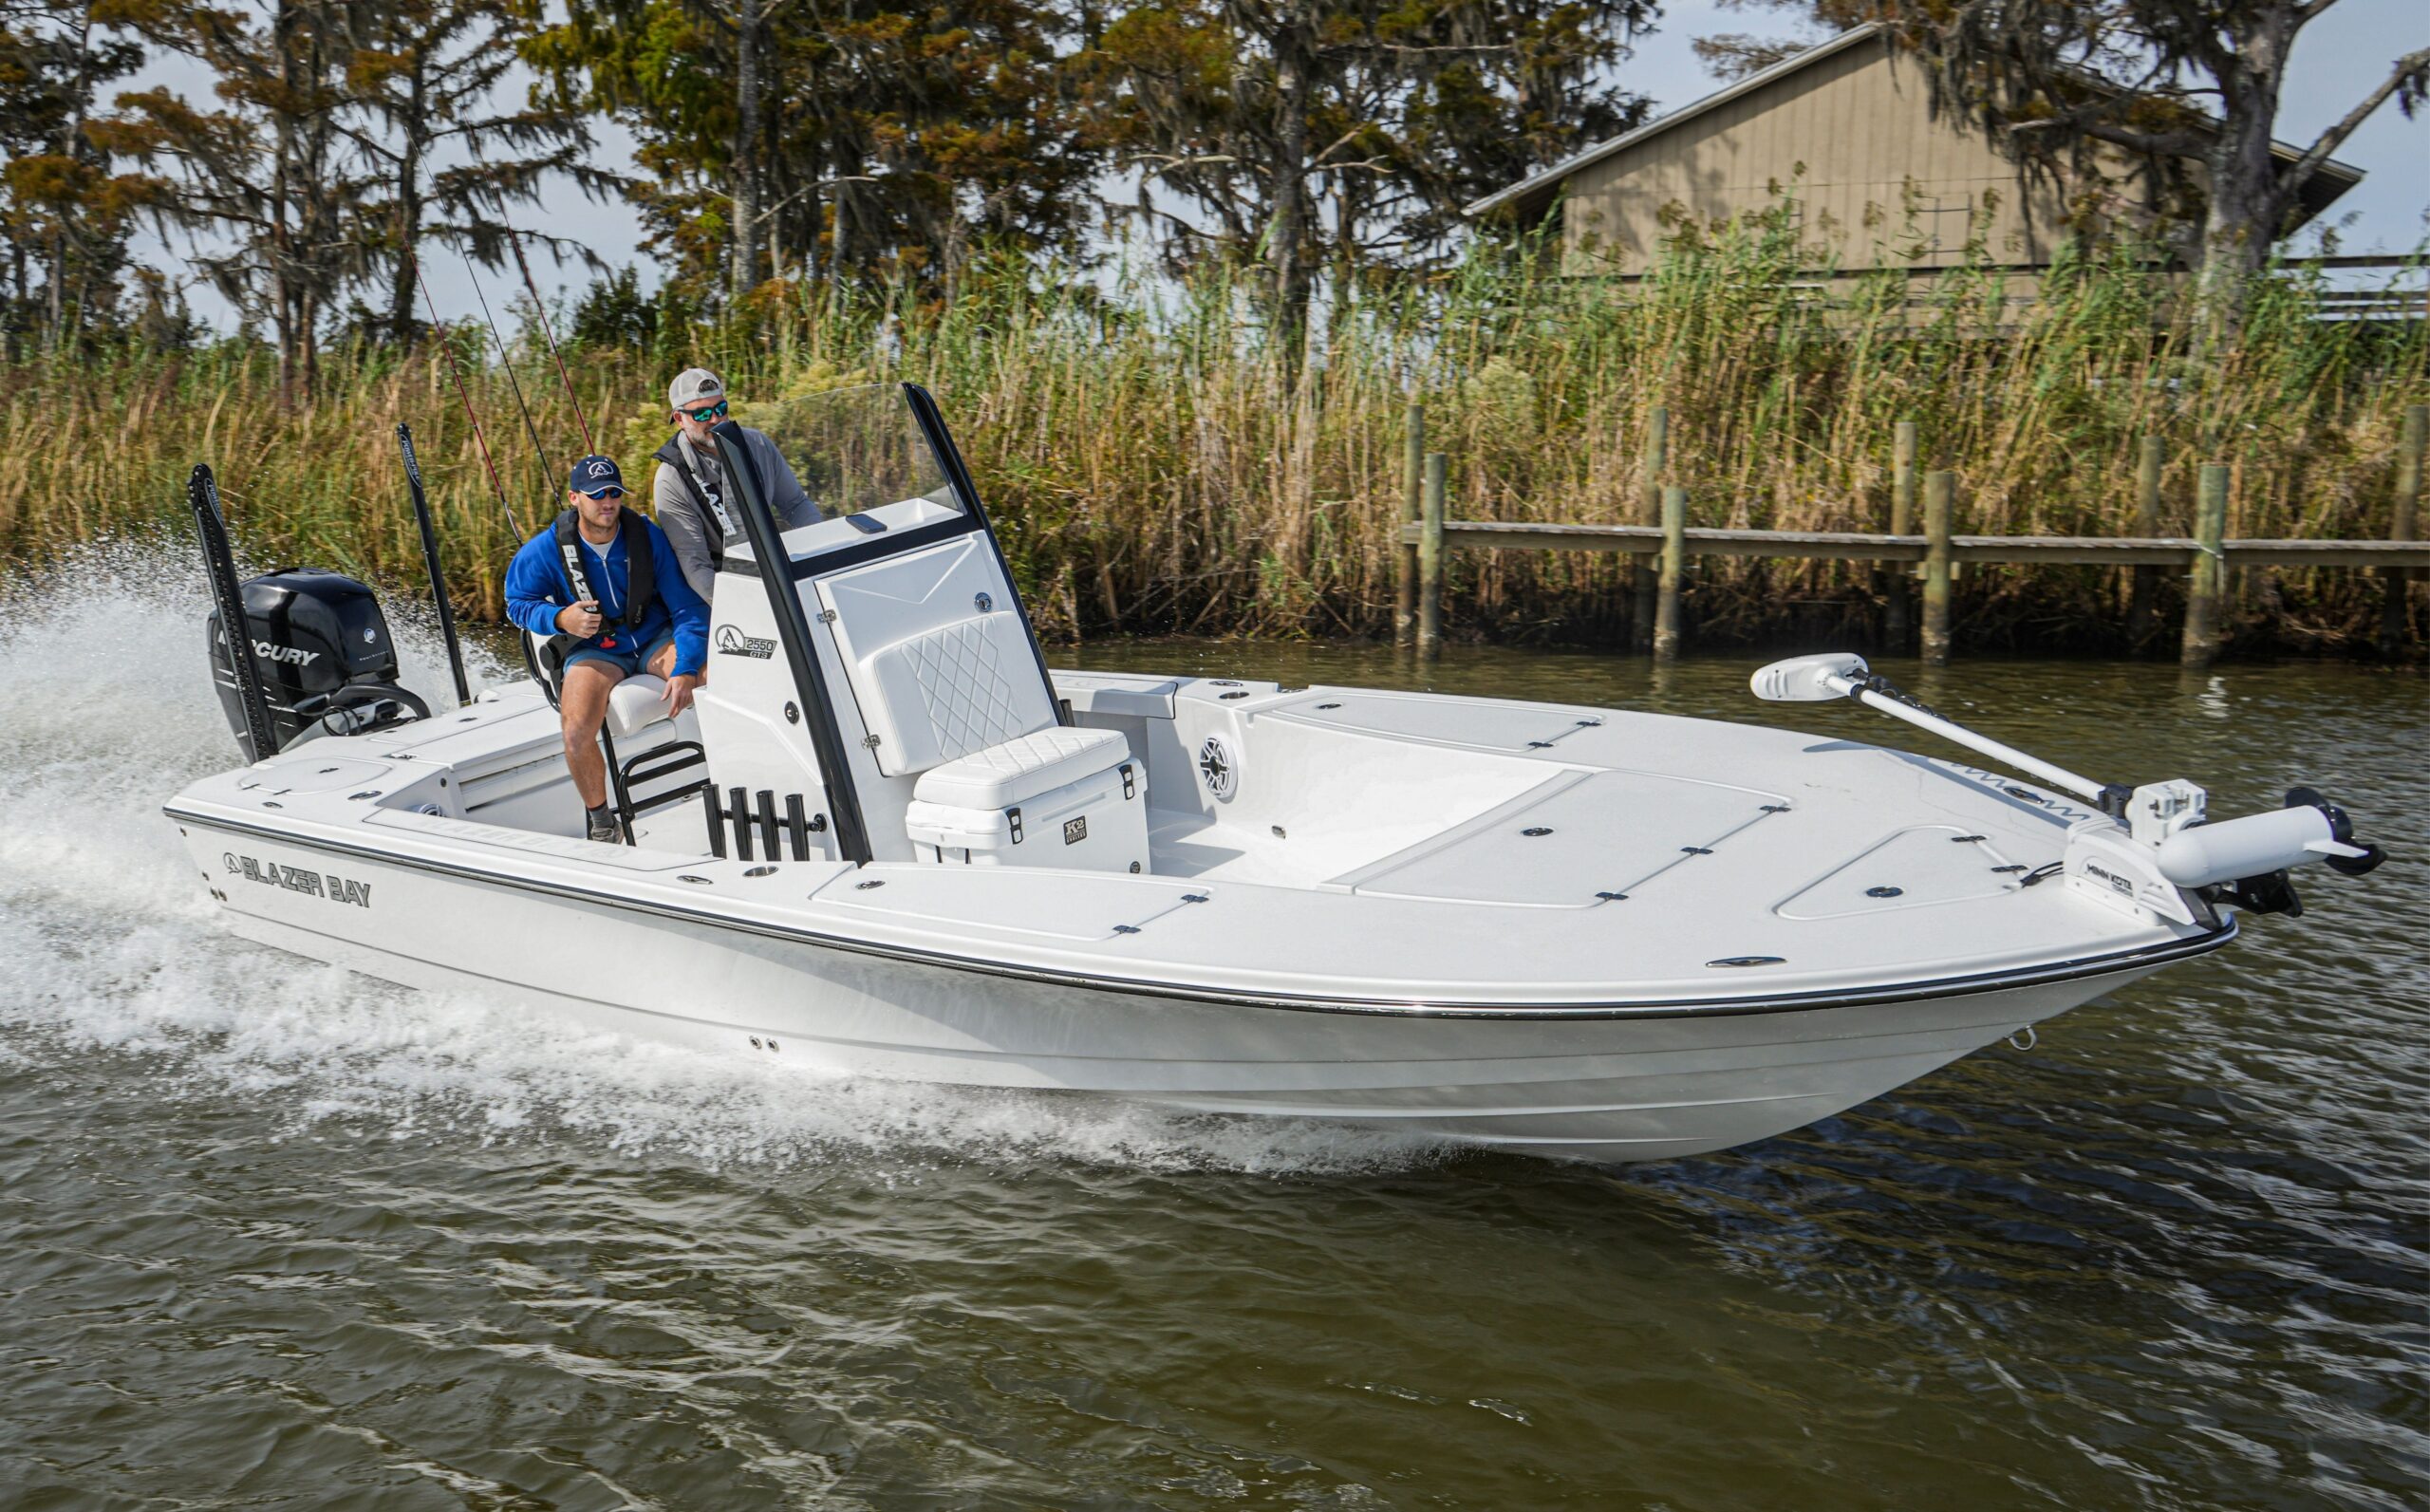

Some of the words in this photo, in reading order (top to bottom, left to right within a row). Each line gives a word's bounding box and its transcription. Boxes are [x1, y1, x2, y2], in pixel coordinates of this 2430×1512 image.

[746, 639, 774, 652] 2550
[749, 651, 768, 660] GTS
[1064, 819, 1085, 835] K2
[240, 855, 325, 898] BLAZER
[326, 875, 371, 908] BAY
